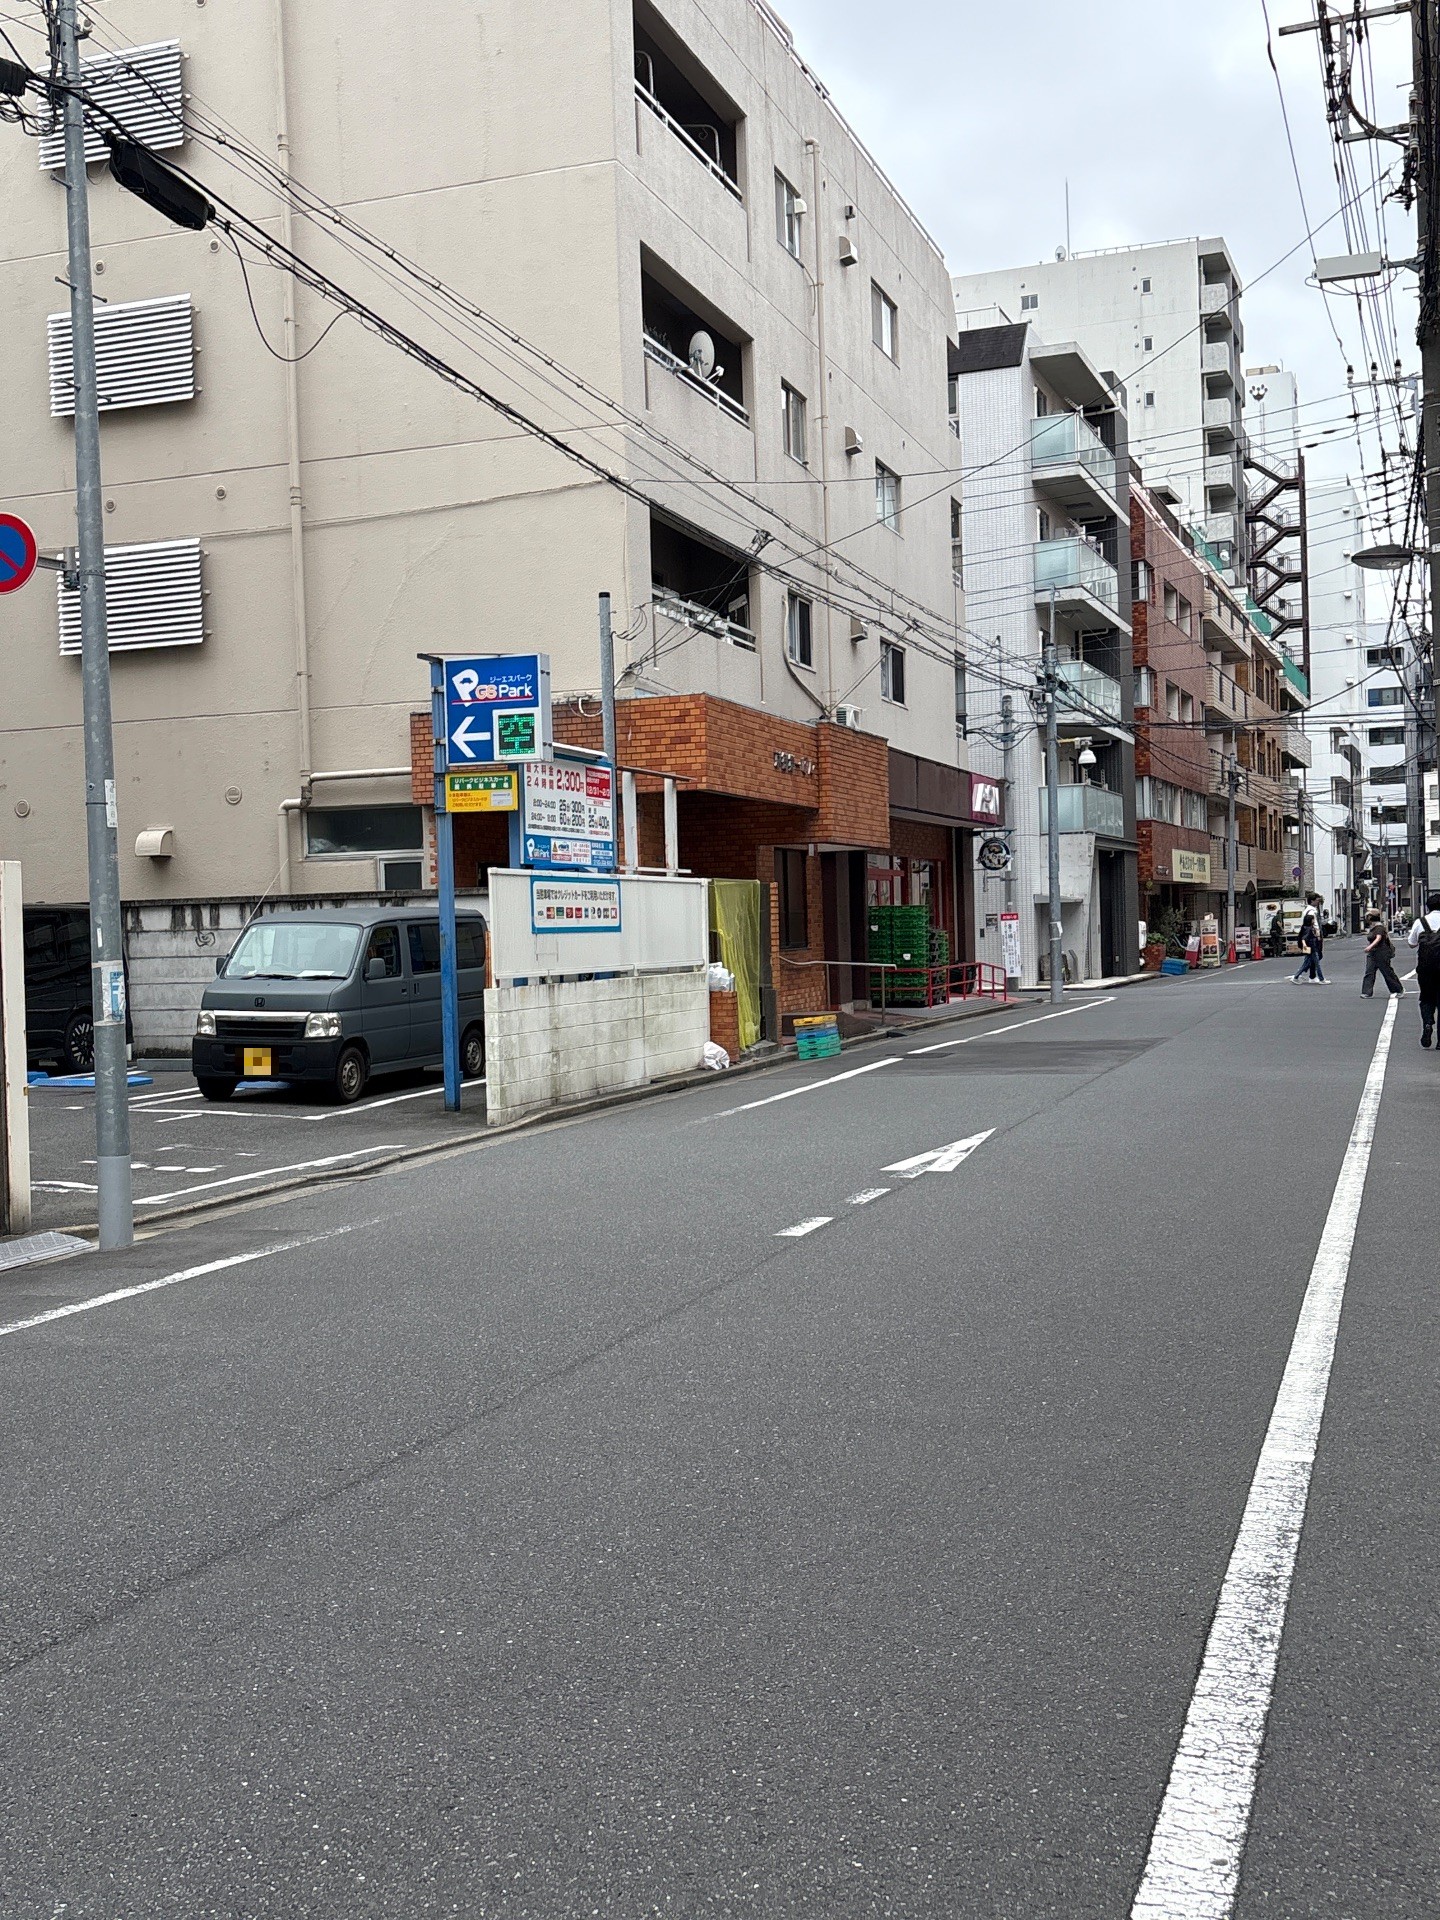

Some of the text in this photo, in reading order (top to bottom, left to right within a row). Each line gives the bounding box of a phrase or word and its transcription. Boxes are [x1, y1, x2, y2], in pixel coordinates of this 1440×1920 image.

[490, 674, 533, 684] ジーエスパーク
[498, 714, 536, 755] 空
[526, 762, 554, 776] 最大料金
[454, 776, 509, 784] リパークビジネスカード
[556, 769, 585, 793] 2,300円
